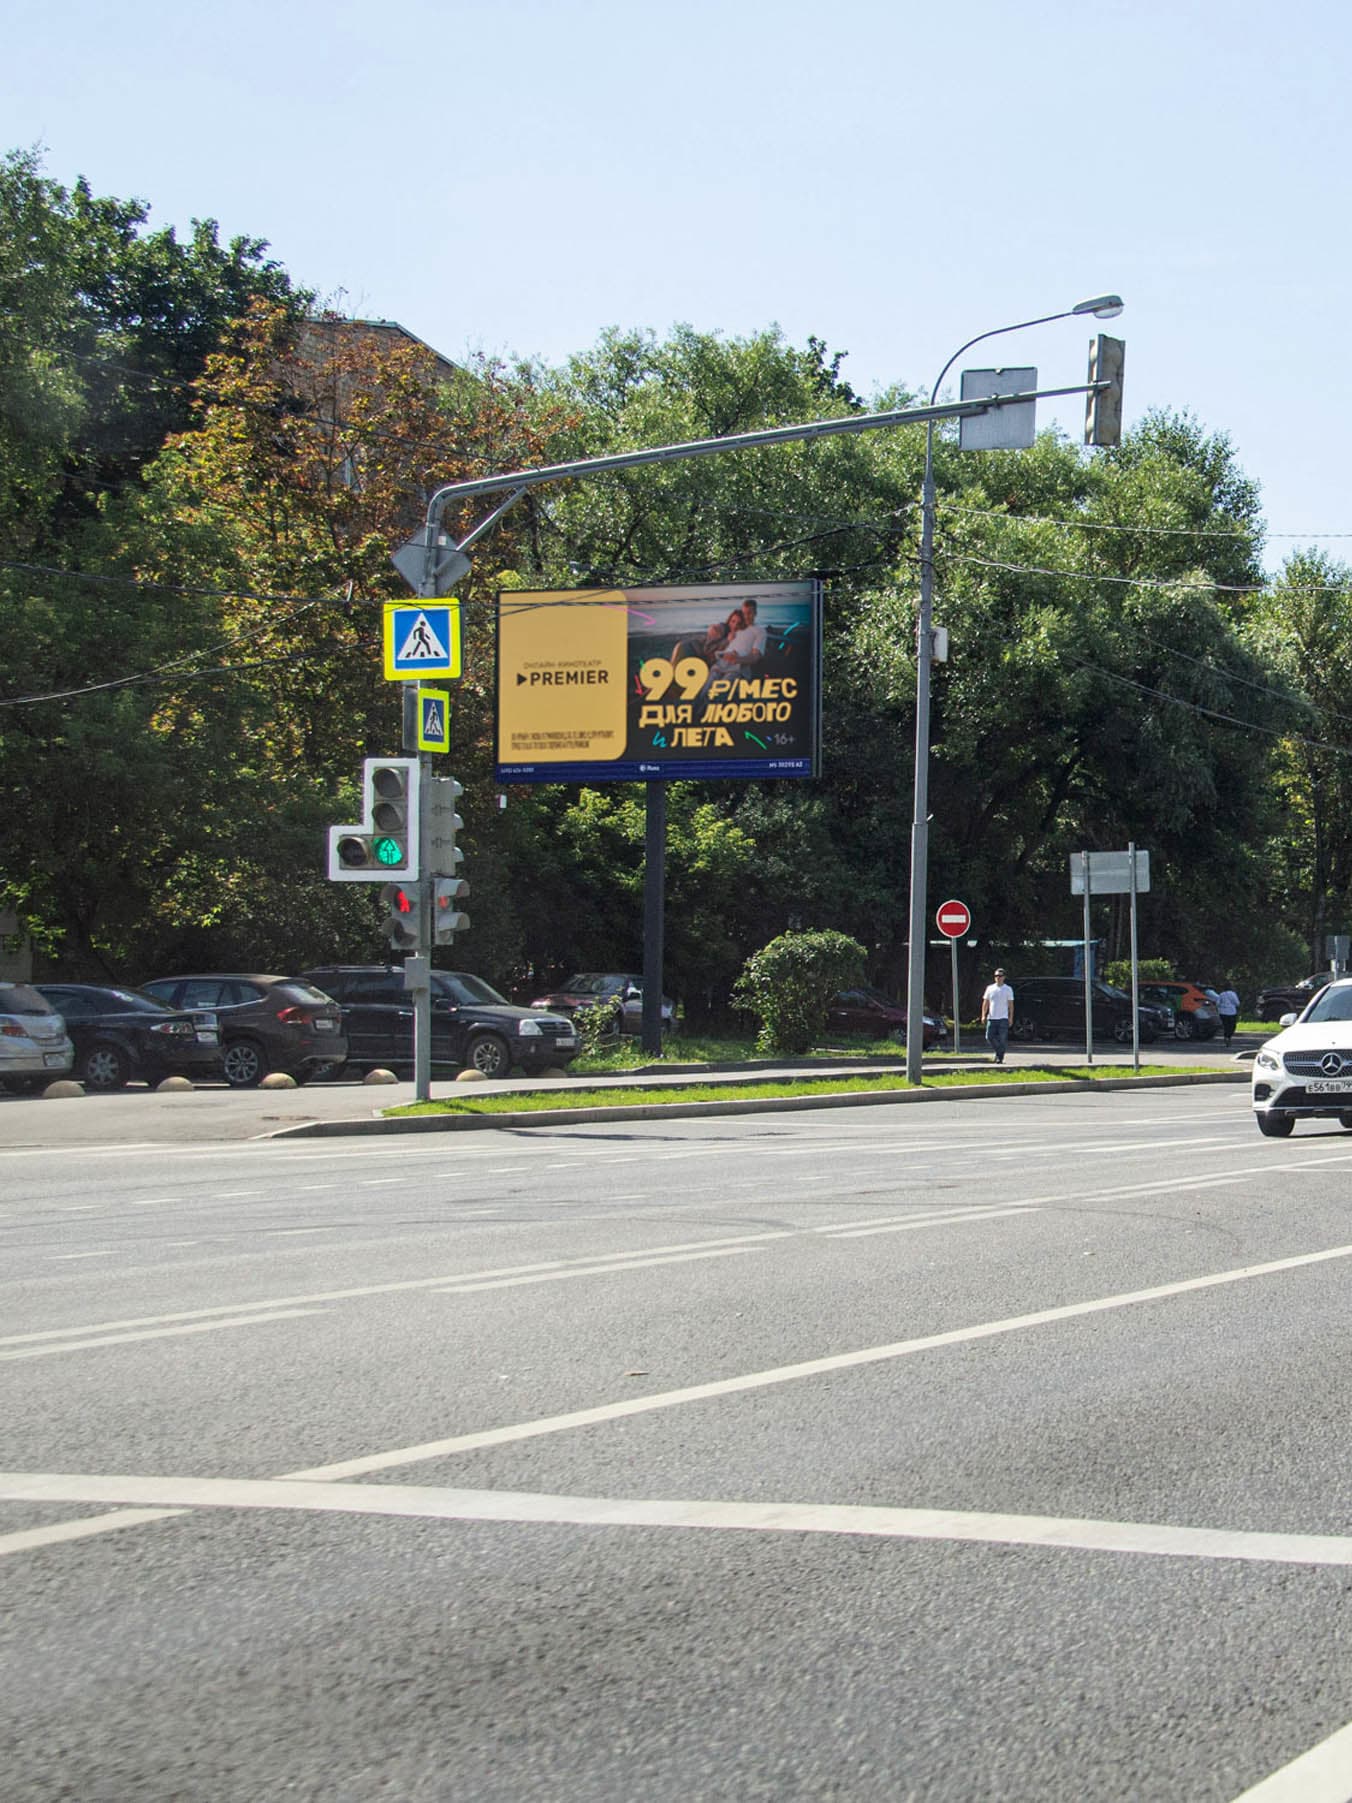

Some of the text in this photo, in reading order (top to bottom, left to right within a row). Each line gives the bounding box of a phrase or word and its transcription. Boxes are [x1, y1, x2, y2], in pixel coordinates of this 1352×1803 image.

[530, 670, 609, 686] PREMIER
[639, 656, 798, 701] 99 ₽/МЕС
[638, 702, 792, 728] ДЛЯ ЛЮБОГО
[670, 727, 735, 748] ЛЕТА
[774, 733, 796, 746] 16+
